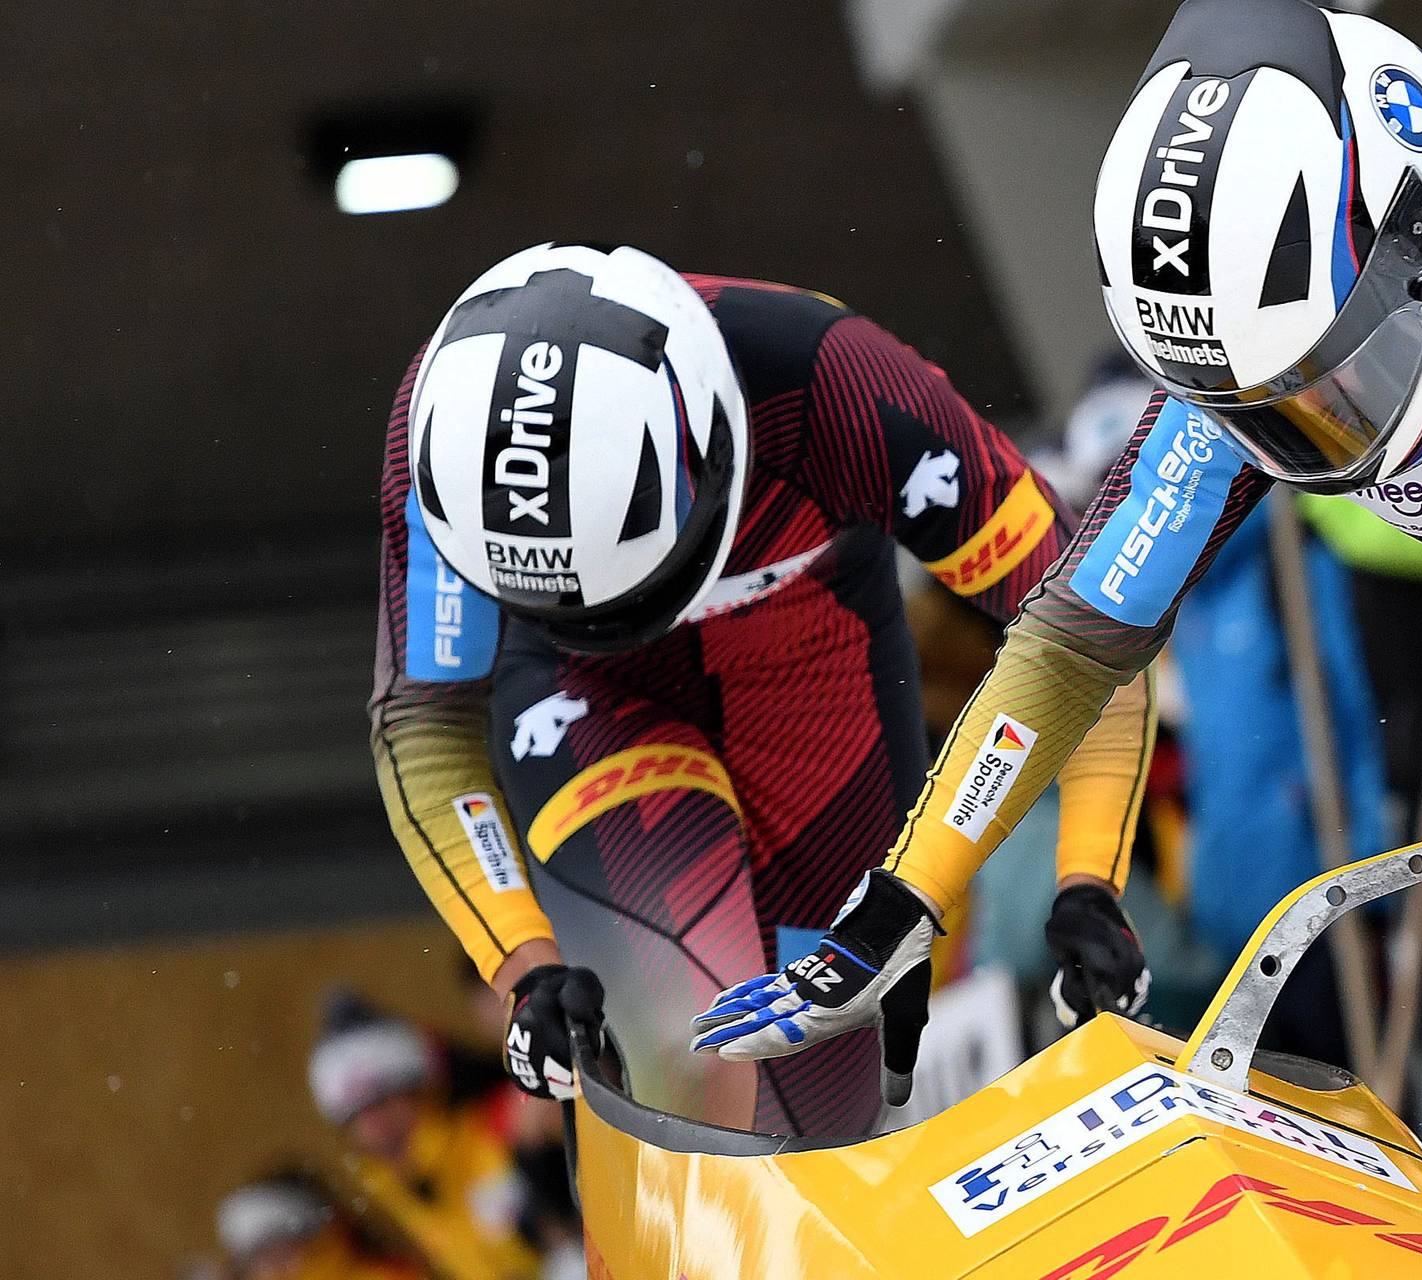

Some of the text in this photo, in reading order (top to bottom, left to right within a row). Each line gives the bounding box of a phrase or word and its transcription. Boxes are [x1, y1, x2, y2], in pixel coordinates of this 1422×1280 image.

[1374, 72, 1404, 134] BMW
[1142, 78, 1231, 278] xDrive
[1135, 296, 1214, 336] BMW
[1145, 333, 1228, 366] helmets
[495, 341, 564, 527] xDrive
[485, 541, 573, 569] BMW
[490, 566, 579, 593] helmets
[952, 753, 1002, 826] Sportlife
[981, 762, 1013, 808] Deutsche
[1077, 1072, 1381, 1163] IDEAL
[971, 1096, 1391, 1211] Versicherung
